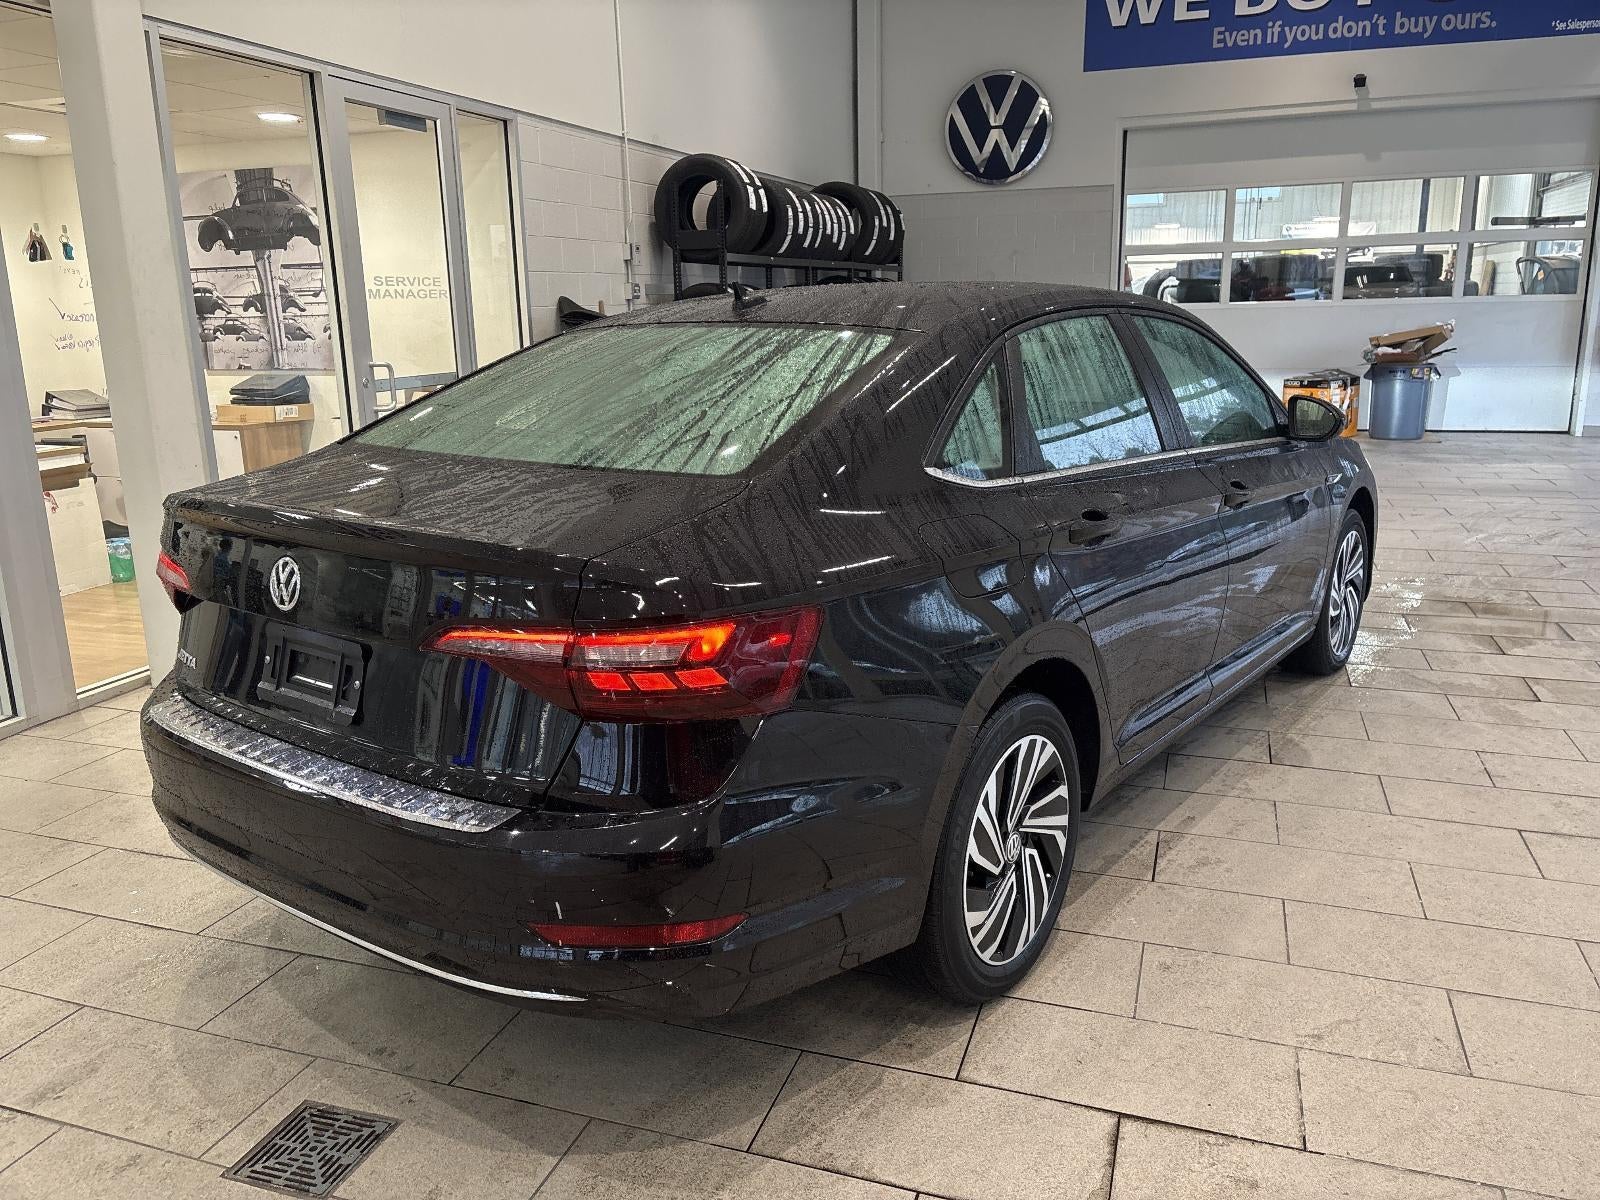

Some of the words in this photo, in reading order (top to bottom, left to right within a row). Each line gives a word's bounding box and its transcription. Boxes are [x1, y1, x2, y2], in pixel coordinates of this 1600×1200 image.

[1212, 26, 1262, 48] Even
[1266, 20, 1282, 44] if
[1283, 23, 1325, 48] you
[1328, 14, 1388, 39] don't
[1394, 11, 1437, 39] buy
[1441, 10, 1498, 31] ours.
[373, 275, 441, 287] SERVICE
[367, 288, 449, 300] MANAGER
